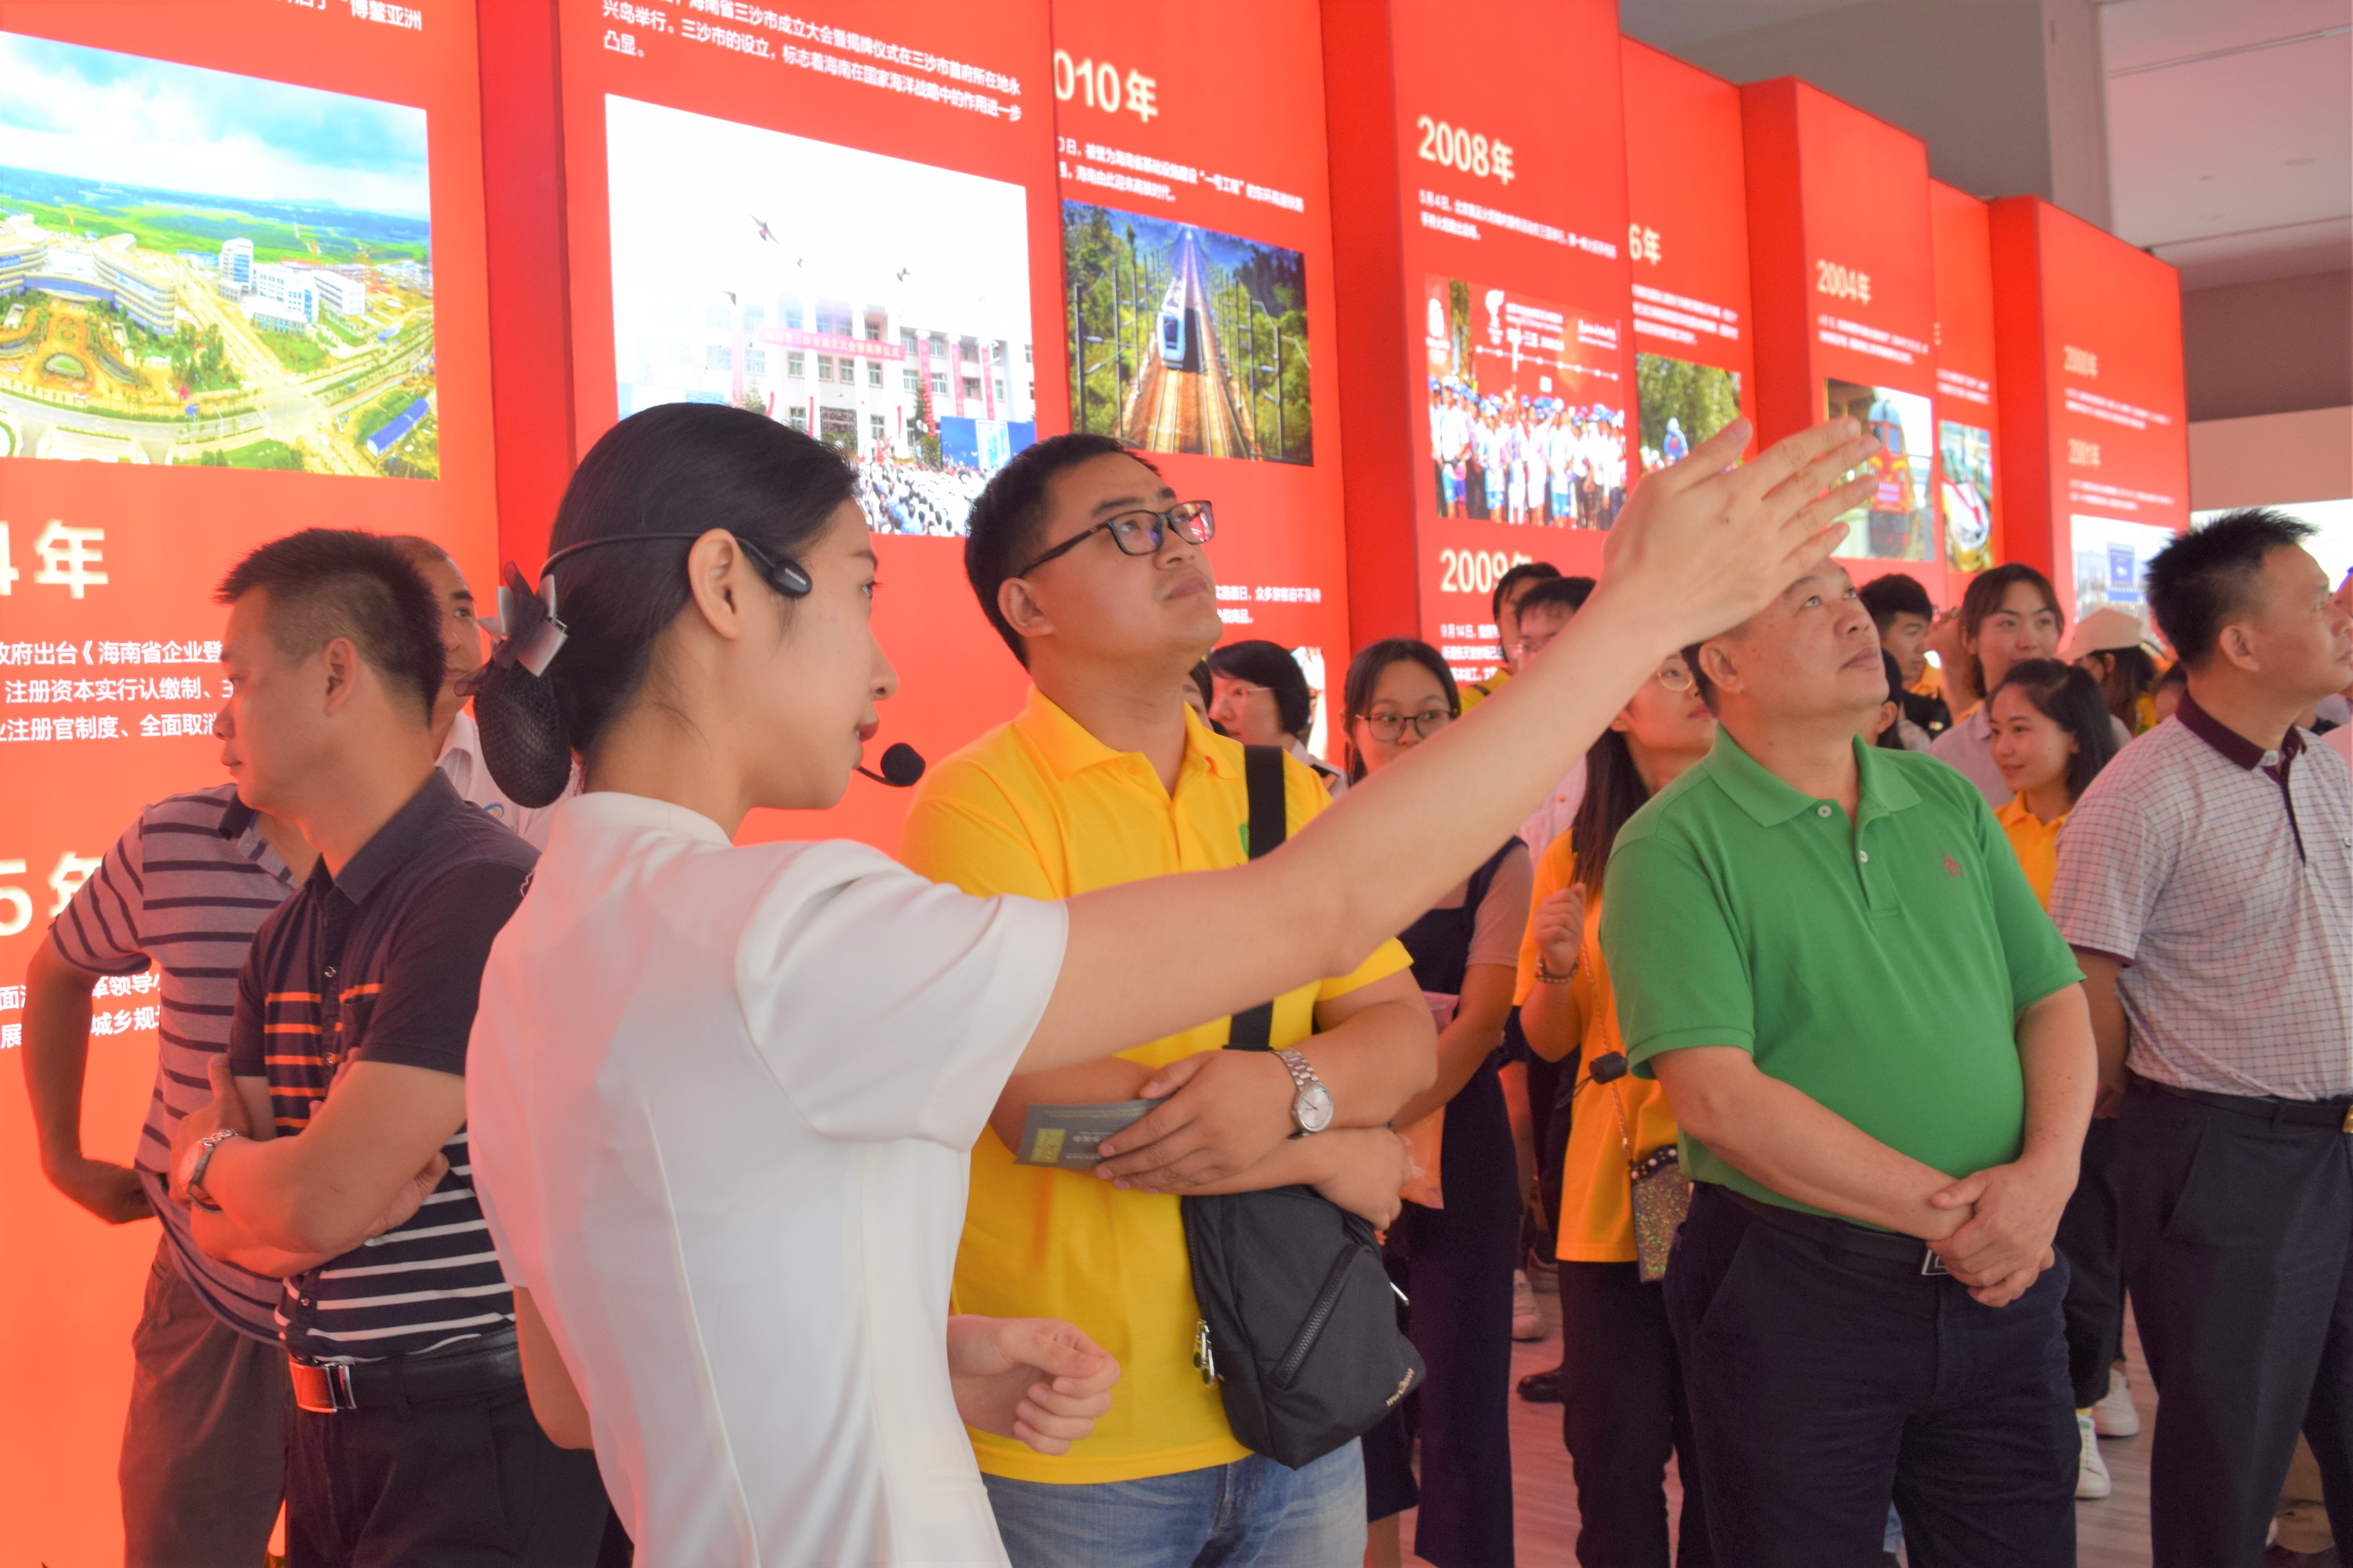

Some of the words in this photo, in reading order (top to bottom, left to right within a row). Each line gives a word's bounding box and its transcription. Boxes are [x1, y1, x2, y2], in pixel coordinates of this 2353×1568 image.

[604, 30, 644, 57] 凸显。
[1418, 114, 1515, 186] 2008年
[1628, 223, 1661, 266] 6年
[1817, 259, 1871, 306] 2004年
[90, 1005, 161, 1036] 城乡规
